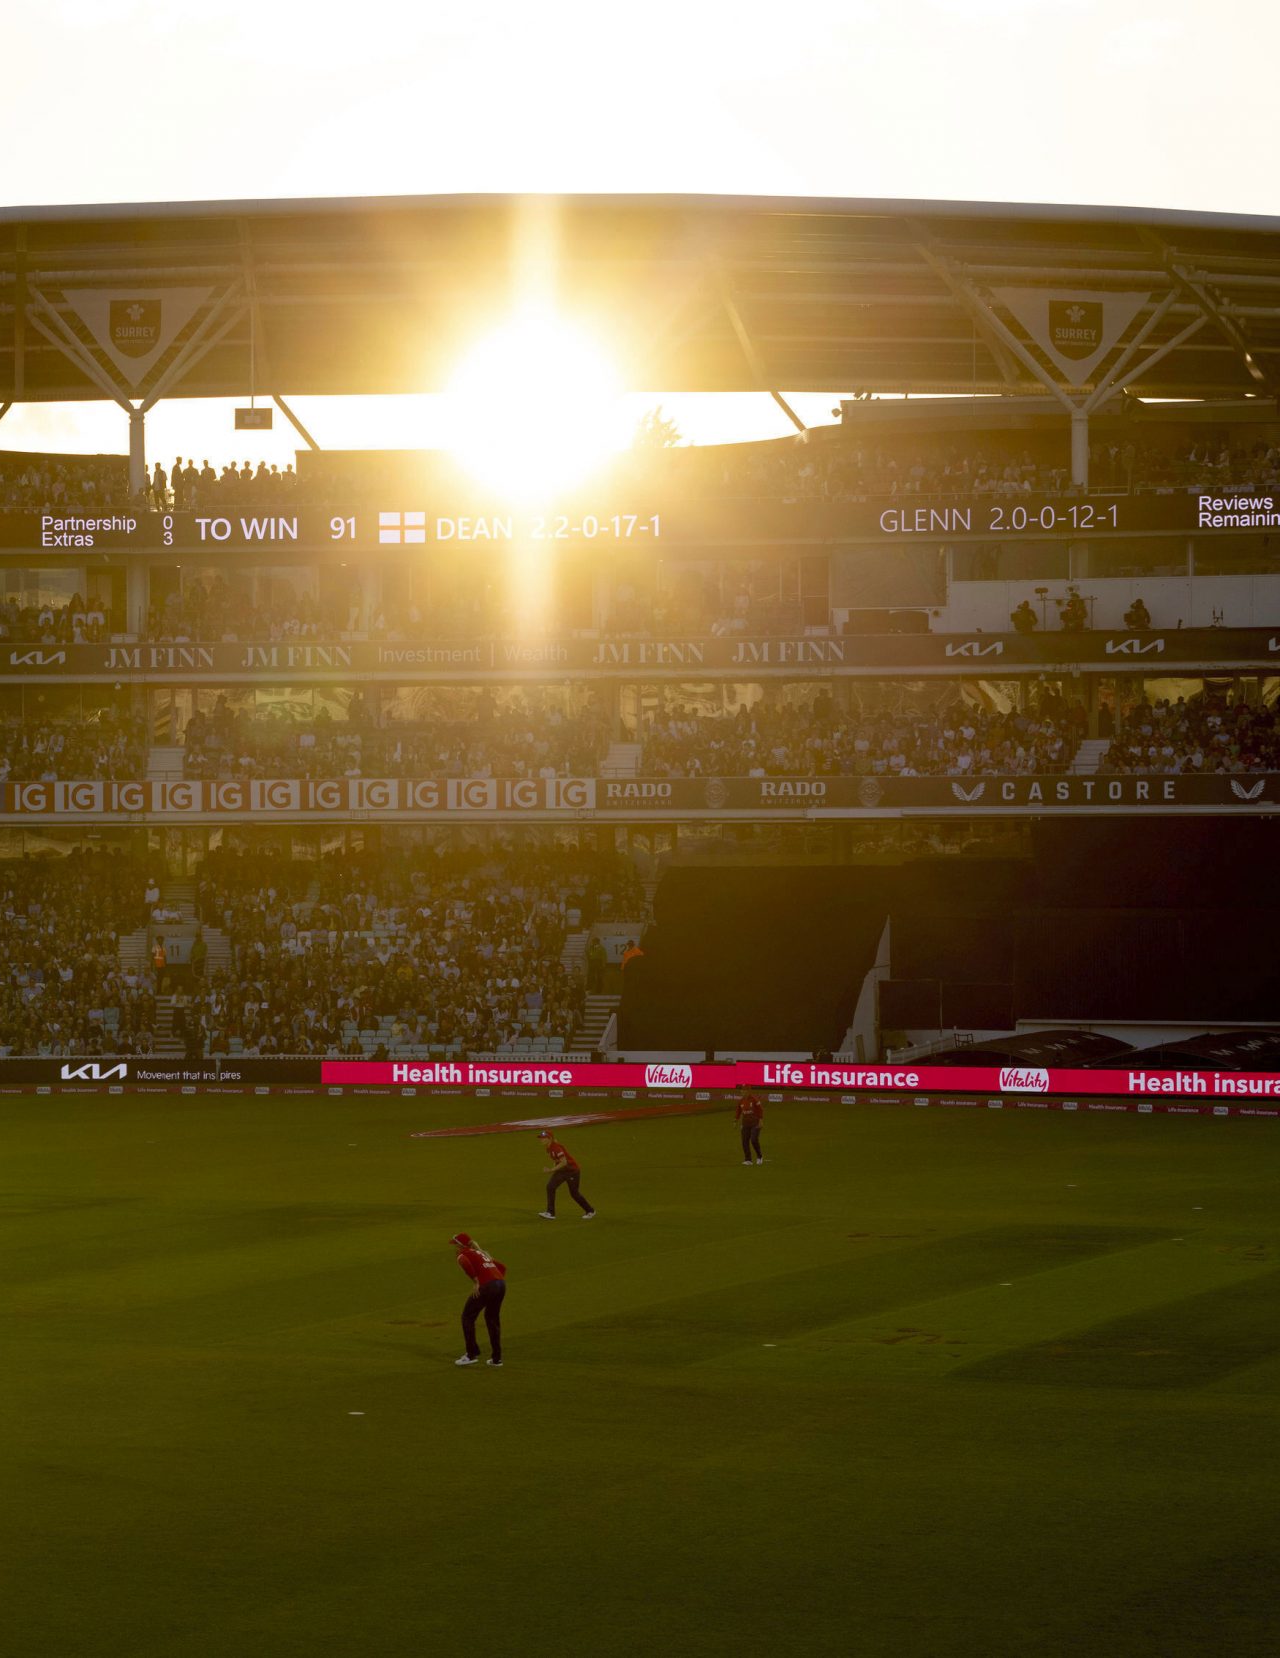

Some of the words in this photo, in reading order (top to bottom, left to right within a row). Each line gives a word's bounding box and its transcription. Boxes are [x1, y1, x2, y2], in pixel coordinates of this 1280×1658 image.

[115, 326, 156, 338] SURREY
[1055, 327, 1097, 339] SURREY
[1198, 495, 1274, 511] Reviews
[41, 515, 137, 535] Partnership
[163, 515, 174, 531] 0
[195, 517, 232, 541] TO
[240, 517, 298, 540] WIN
[329, 516, 357, 539] 91
[437, 516, 513, 540] DEAN
[531, 514, 660, 539] 2.2-0-17-1
[880, 508, 972, 533] GLENN
[989, 504, 1118, 531] 2.0-0-12-1
[1198, 511, 1280, 528] Remainin
[41, 532, 94, 547] Extras
[163, 532, 174, 546] 3
[104, 648, 144, 669] JM
[150, 648, 215, 667] FINN
[241, 647, 280, 669] JM
[287, 646, 352, 667] FINN
[378, 646, 481, 663] Investment
[503, 644, 568, 662] Wealth
[592, 642, 632, 664] JM
[638, 642, 704, 664] FINN
[731, 641, 770, 663] JM
[777, 640, 845, 662] FINN
[14, 783, 47, 811] IG
[63, 783, 96, 811] IG
[112, 783, 144, 811] IG
[161, 783, 193, 810] IG
[211, 782, 243, 810] IG
[260, 782, 292, 809] IG
[309, 782, 341, 809] IG
[358, 781, 390, 808] IG
[407, 781, 439, 808] IG
[457, 781, 489, 808] IG
[505, 780, 538, 808] IG
[555, 780, 587, 808] IG
[606, 783, 671, 798] RADO
[760, 781, 826, 796] RADO
[1001, 780, 1176, 800] CASTORE
[182, 1070, 200, 1080] that
[392, 1064, 463, 1084] Health
[469, 1064, 572, 1085] insurance
[647, 1065, 692, 1086] Vitality
[763, 1064, 804, 1085] Life
[809, 1065, 919, 1088] insurance
[1001, 1068, 1049, 1091] Vitality
[1129, 1072, 1207, 1093] Health
